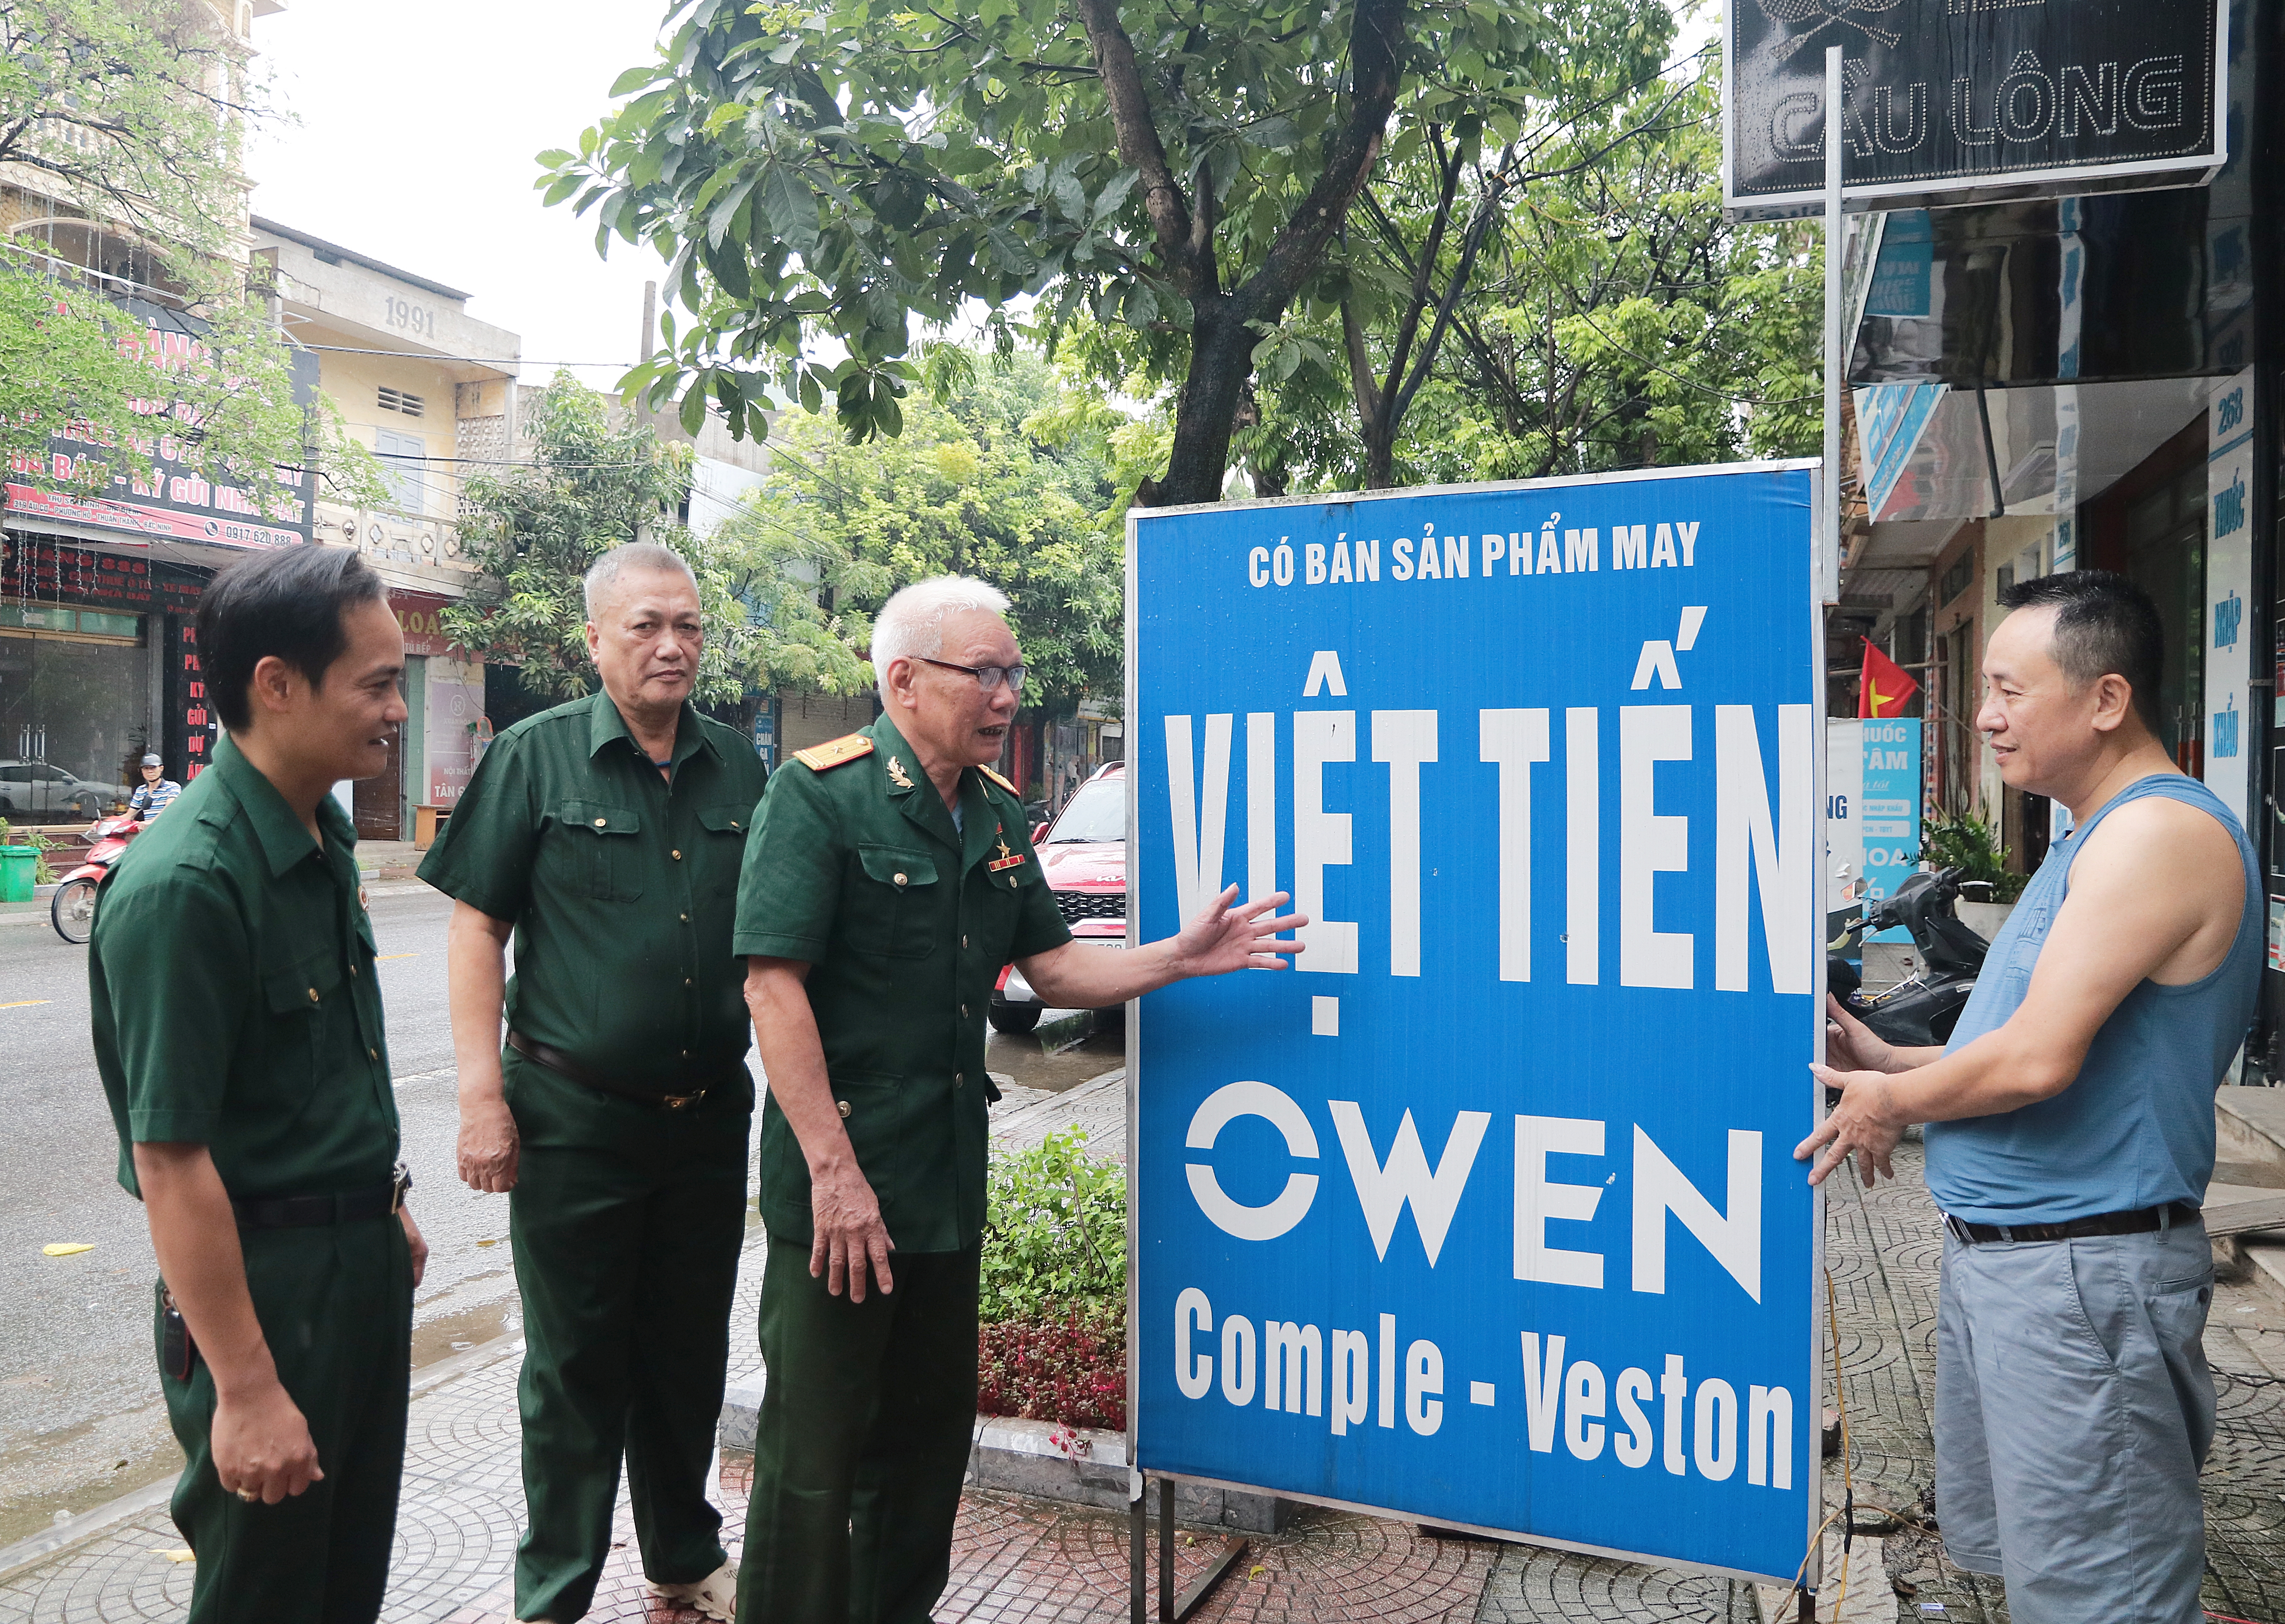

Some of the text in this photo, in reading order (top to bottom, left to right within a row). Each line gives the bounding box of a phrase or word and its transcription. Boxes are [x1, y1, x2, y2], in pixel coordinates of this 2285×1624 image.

[1951, 49, 2184, 147] LÔNG
[385, 296, 435, 339] 1991
[2218, 386, 2243, 436] 268
[170, 471, 210, 508] GỬI
[157, 522, 172, 532] NINH
[226, 526, 291, 546] 0917 620 888
[1249, 512, 1700, 588] CÓ BÁN SẢN PHẨM MAY
[397, 610, 441, 641] LOẠ
[187, 703, 207, 726] GỬI
[1863, 721, 1907, 743] UỐC
[434, 782, 455, 798] TÂN
[1164, 605, 1813, 1037] VIỆT TIẾN
[1185, 1080, 1763, 1304] OWEN
[1175, 1287, 1793, 1490] Comple - Veston
